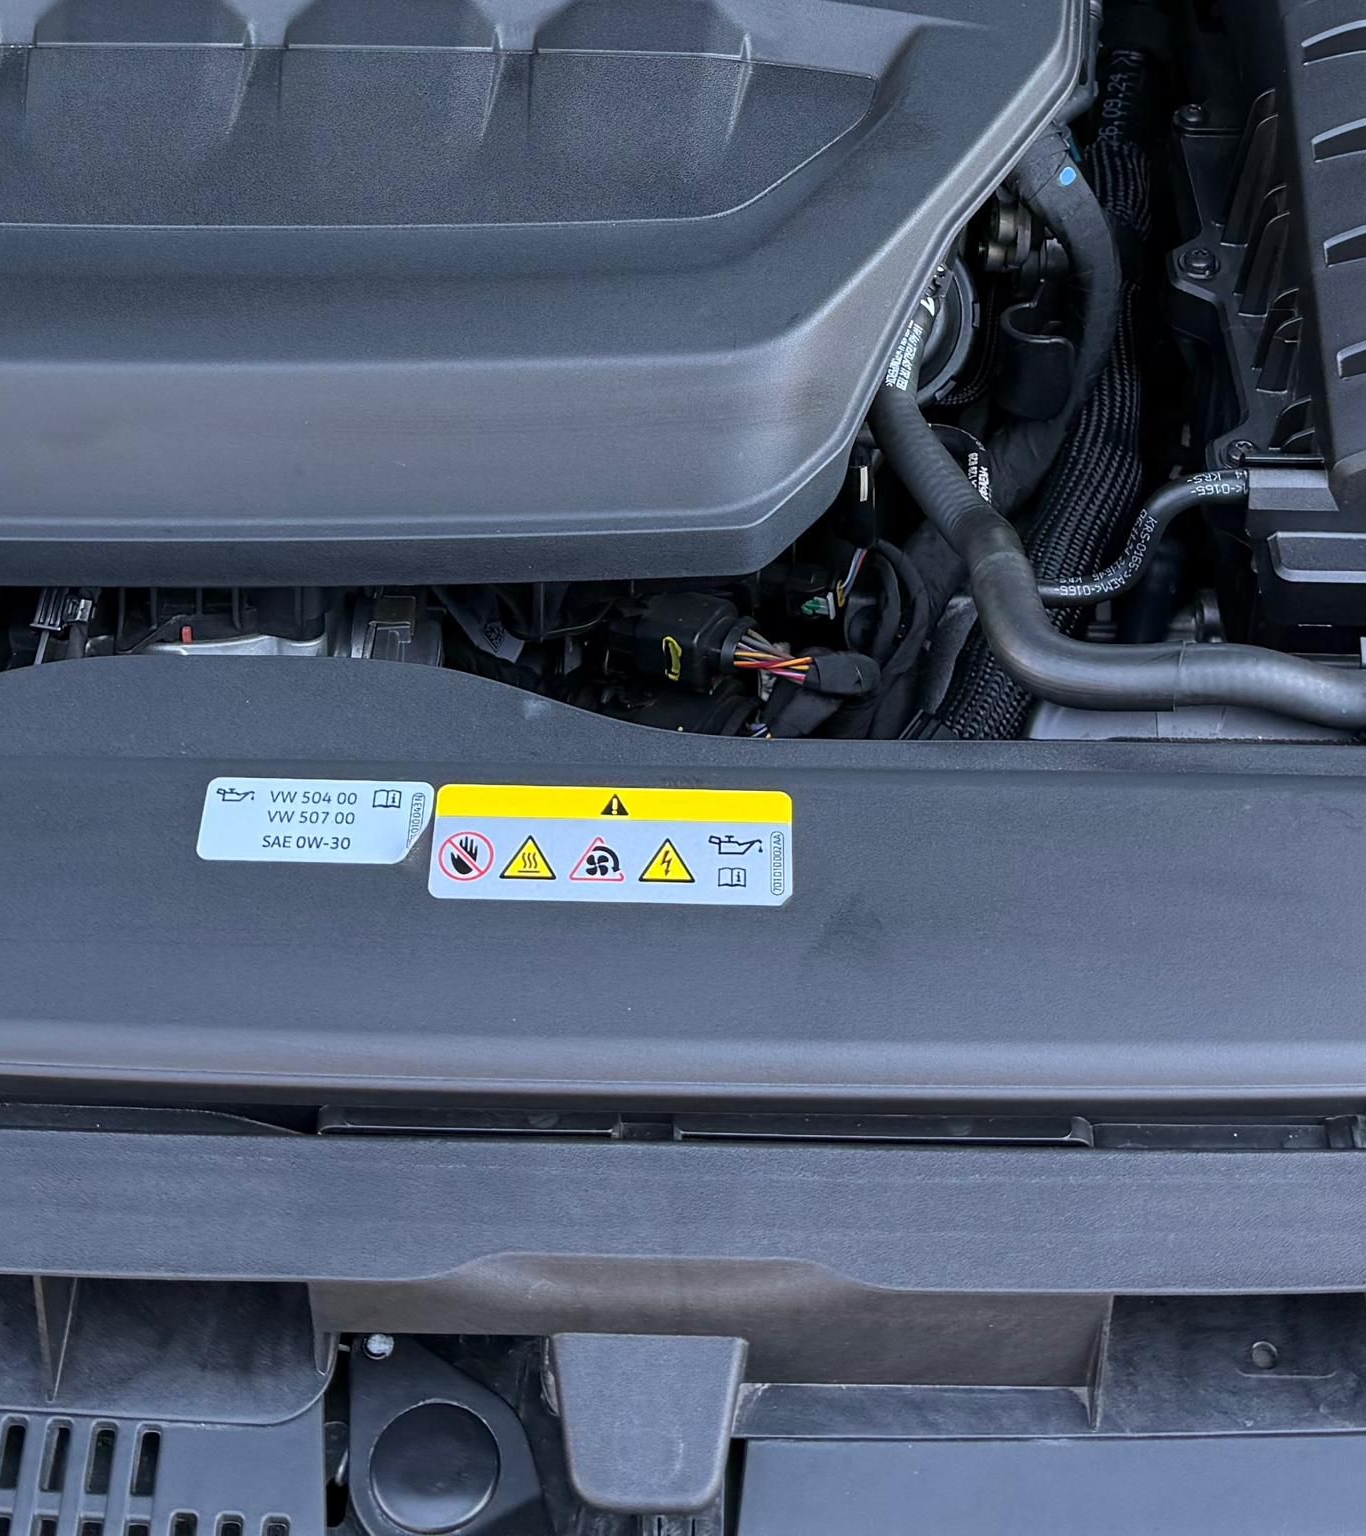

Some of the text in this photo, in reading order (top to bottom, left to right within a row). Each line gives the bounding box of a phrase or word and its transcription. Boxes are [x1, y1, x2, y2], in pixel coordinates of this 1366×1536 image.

[270, 790, 358, 806] VW 504 00
[267, 810, 356, 826] VW 507 00
[262, 835, 351, 851] SAE 0W-30
